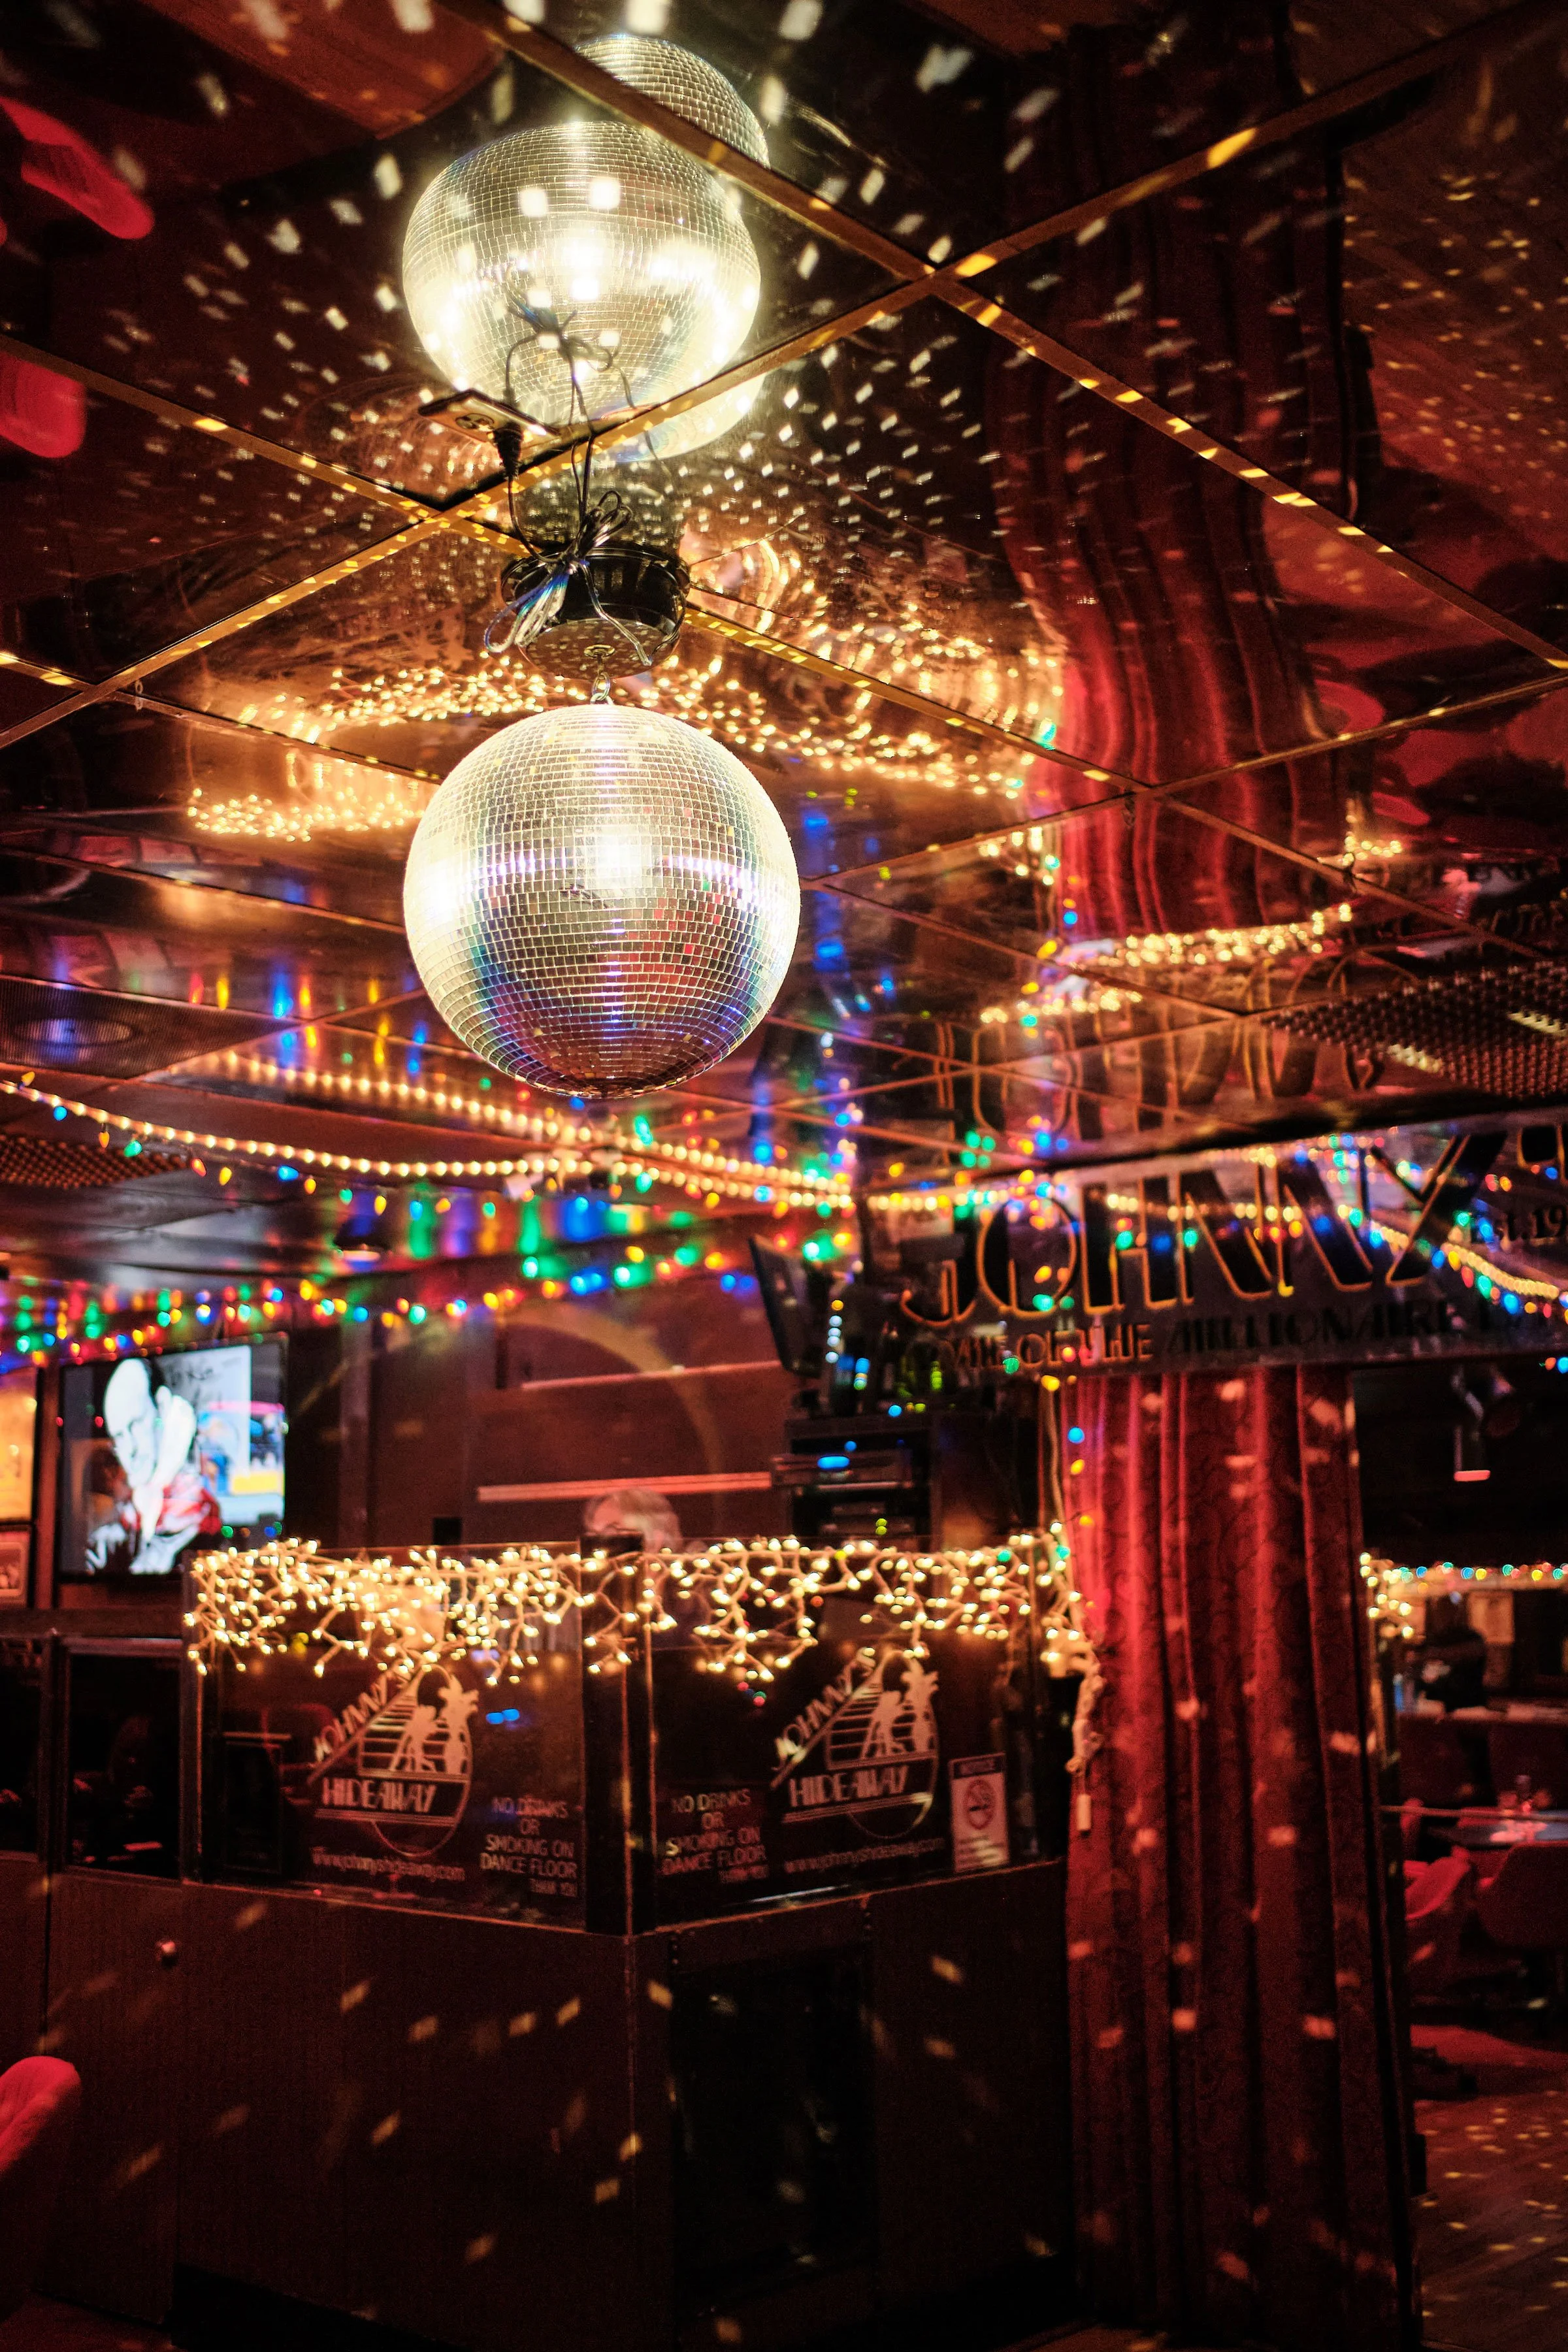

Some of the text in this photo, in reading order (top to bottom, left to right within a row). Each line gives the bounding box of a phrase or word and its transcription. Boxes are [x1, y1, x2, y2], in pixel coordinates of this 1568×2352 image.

[322, 1776, 437, 1813] HIDEAWAY
[788, 1765, 910, 1808] HIDEAWAY
[491, 1797, 515, 1814] NO
[670, 1795, 694, 1814] NO
[520, 1818, 540, 1835] OR
[701, 1812, 725, 1829] OR
[485, 1834, 575, 1859] SMOKING ON
[737, 1827, 761, 1845] ON
[480, 1852, 578, 1879] DANCE FLOOR
[661, 1845, 767, 1876] DANCE FLOOR
